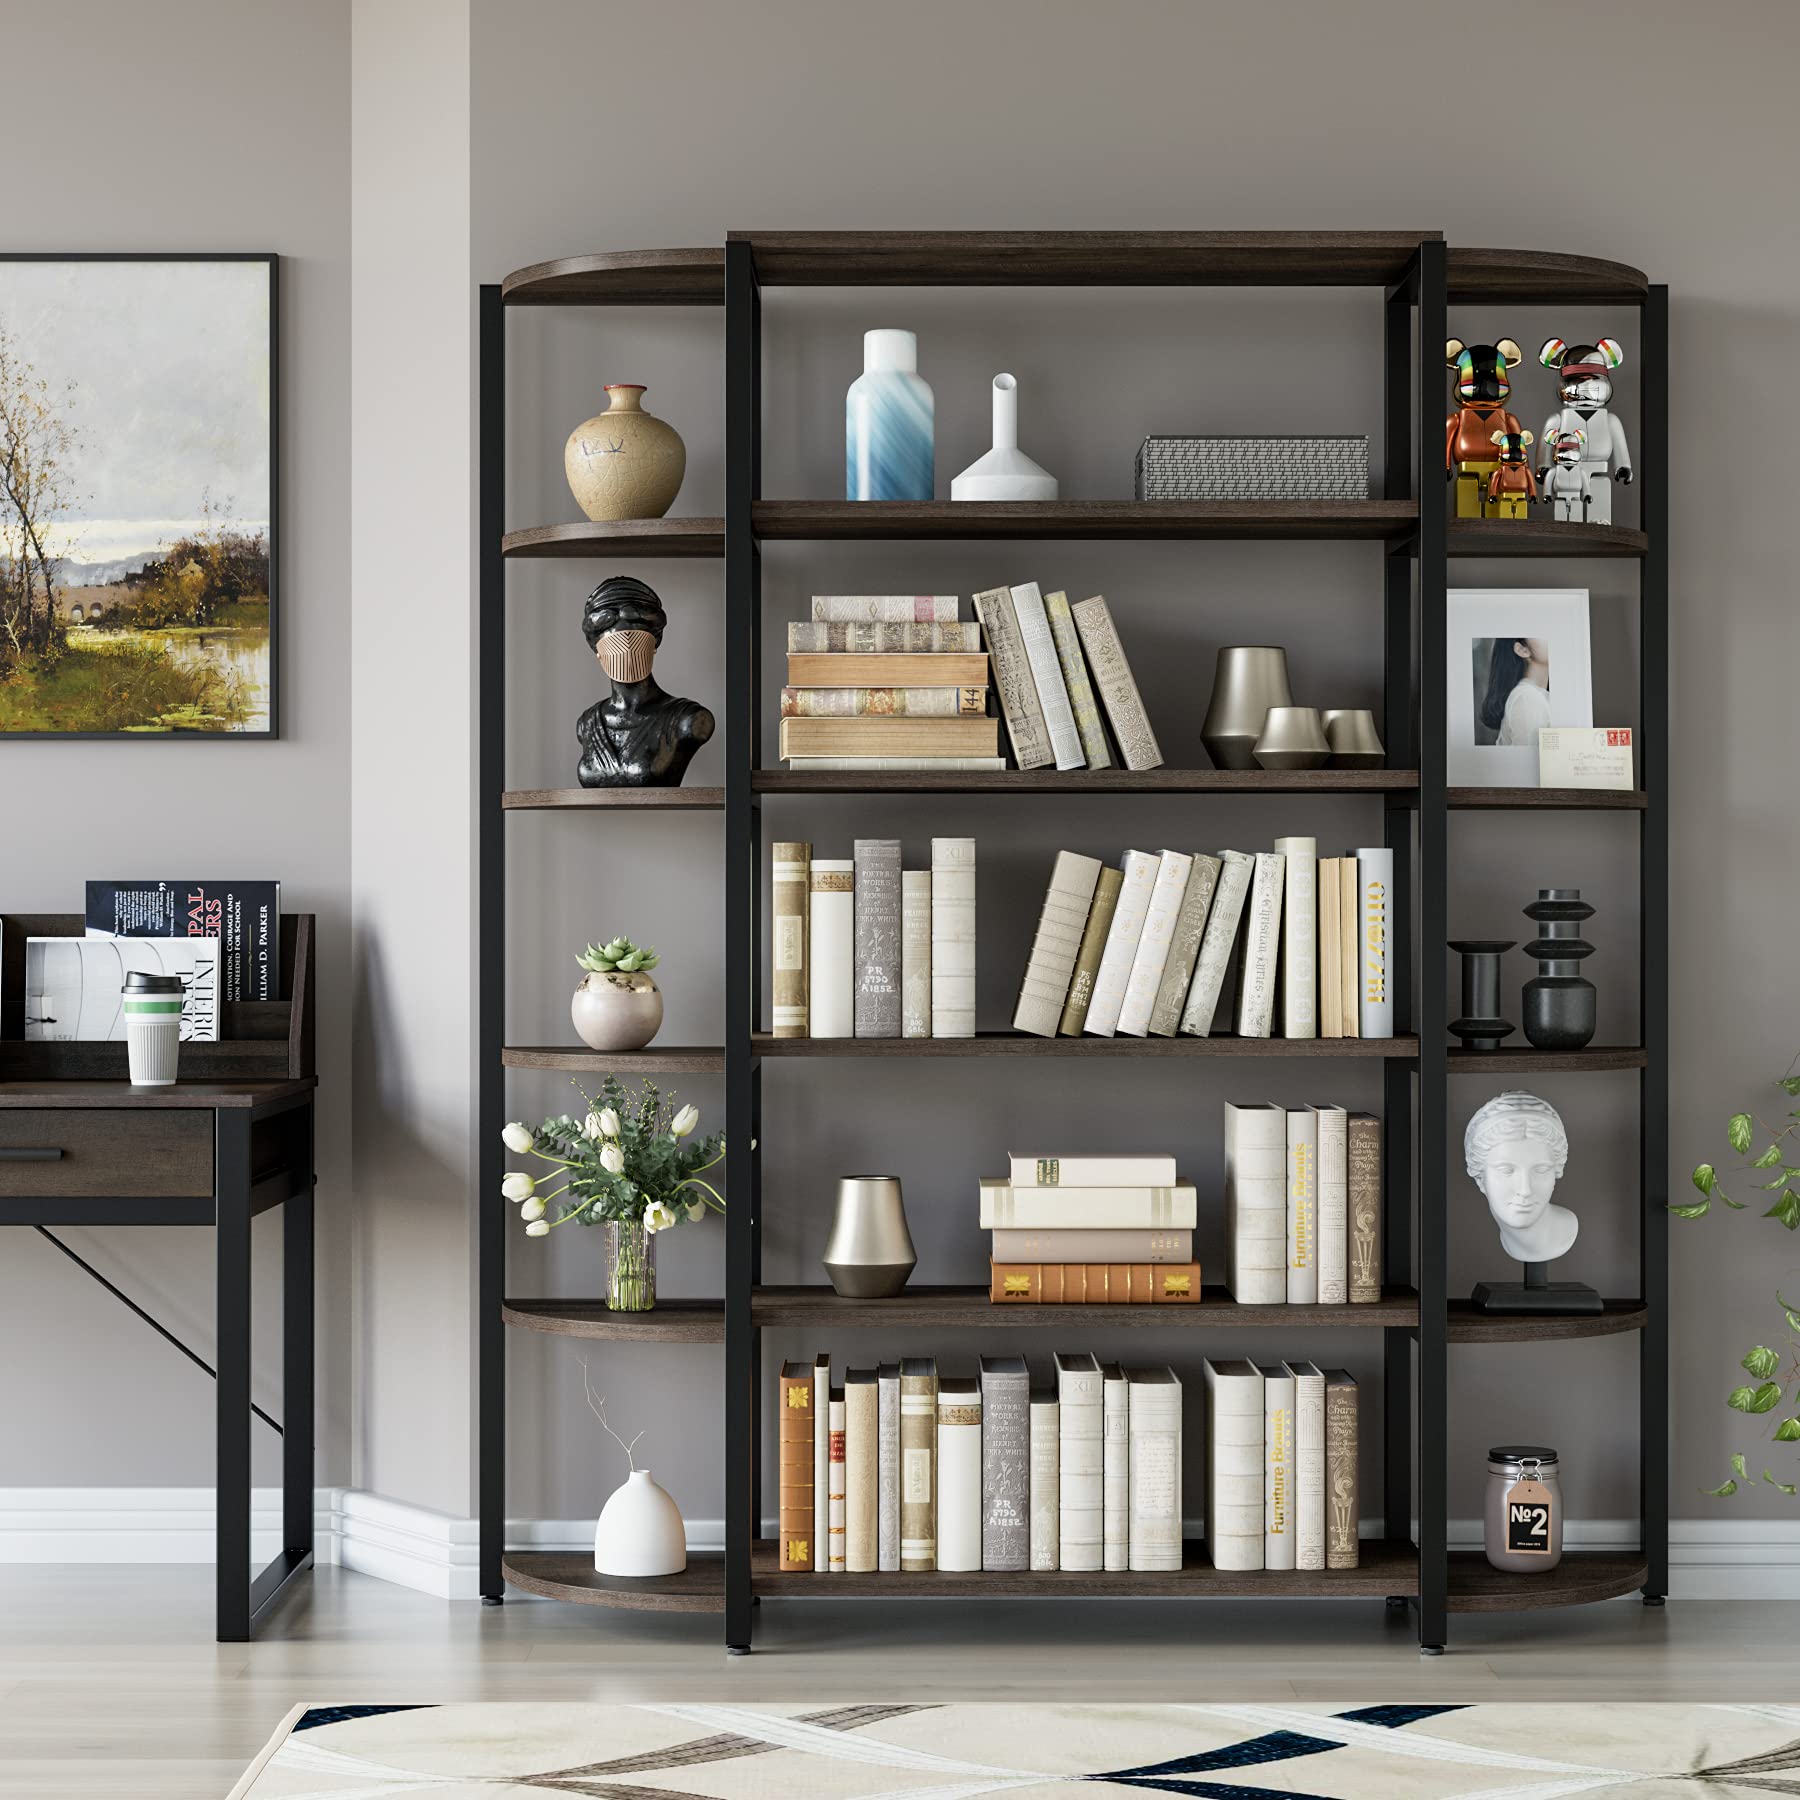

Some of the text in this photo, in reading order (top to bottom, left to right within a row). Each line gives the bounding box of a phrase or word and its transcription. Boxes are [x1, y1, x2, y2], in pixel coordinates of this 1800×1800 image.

[962, 688, 980, 712] 144
[259, 905, 268, 945] PARKER
[226, 914, 234, 952] COURAGE
[259, 949, 267, 960] D.
[865, 966, 883, 975] PR
[864, 976, 888, 984] 5790
[861, 984, 896, 992] A1852
[1350, 1139, 1378, 1149] Charm
[1293, 1143, 1307, 1268] Furniture Brands
[1328, 1404, 1356, 1414] Charm
[991, 1412, 1018, 1420] WORKS
[1271, 1409, 1284, 1534] Furniture Brands
[994, 1500, 1011, 1509] PR
[992, 1508, 1016, 1517] 5790
[989, 1517, 1024, 1527] A1852
